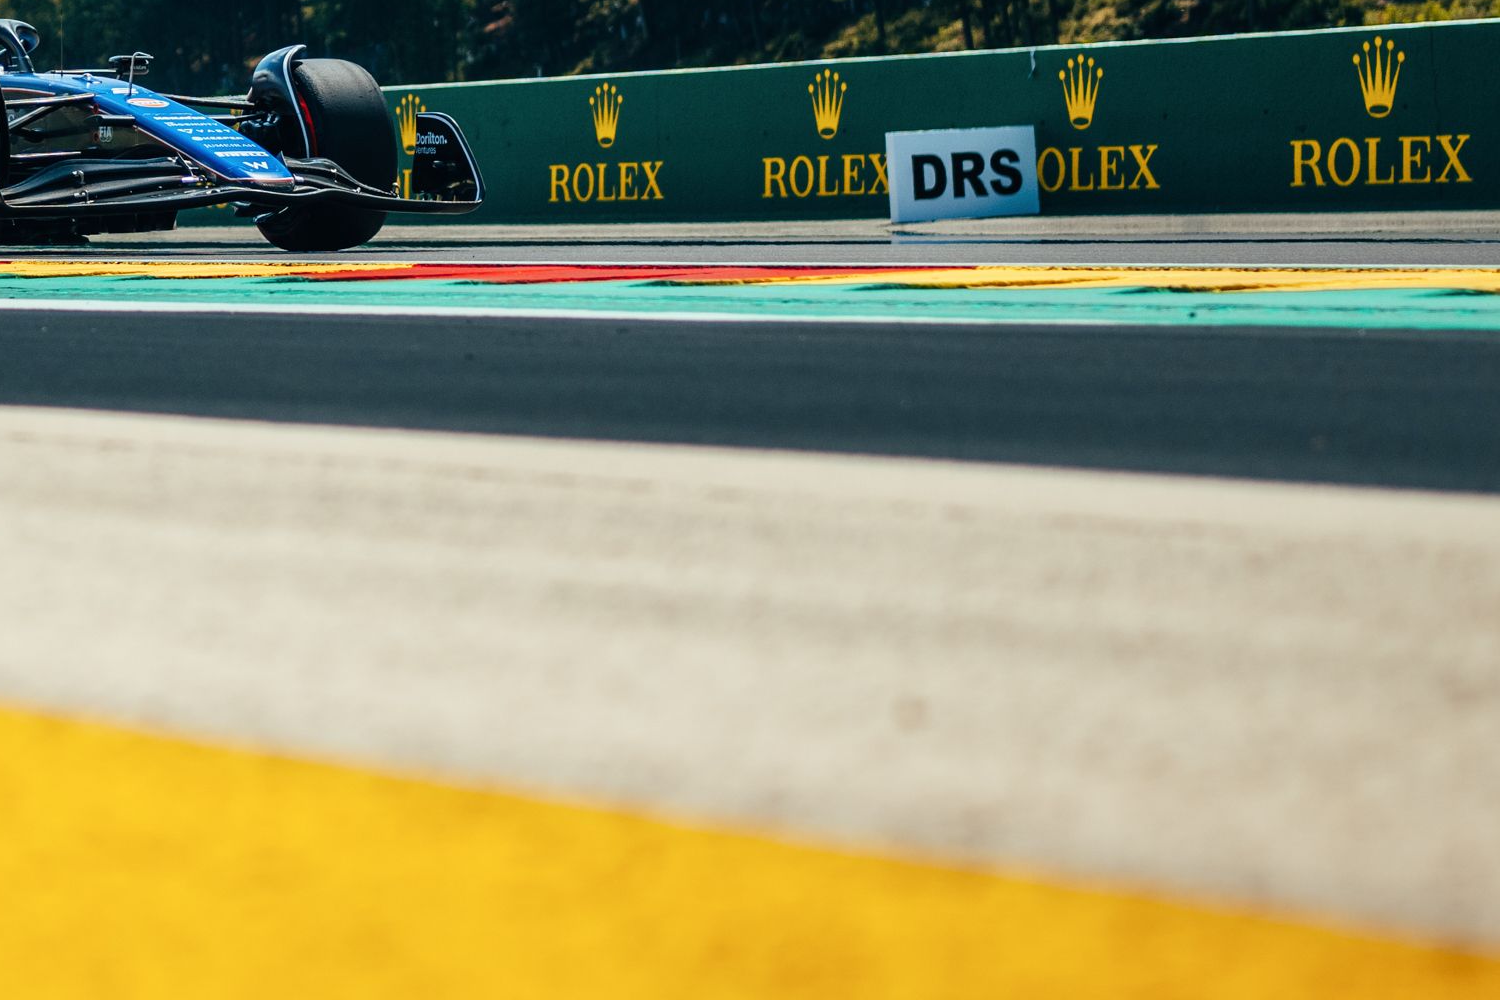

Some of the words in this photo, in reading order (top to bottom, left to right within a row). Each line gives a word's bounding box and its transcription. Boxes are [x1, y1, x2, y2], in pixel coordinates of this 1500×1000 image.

[548, 160, 664, 203] ROLEX
[762, 153, 890, 199] ROLEX
[911, 148, 1023, 201] DRS
[1037, 144, 1161, 192] OLEX
[1289, 134, 1474, 188] ROLEX
